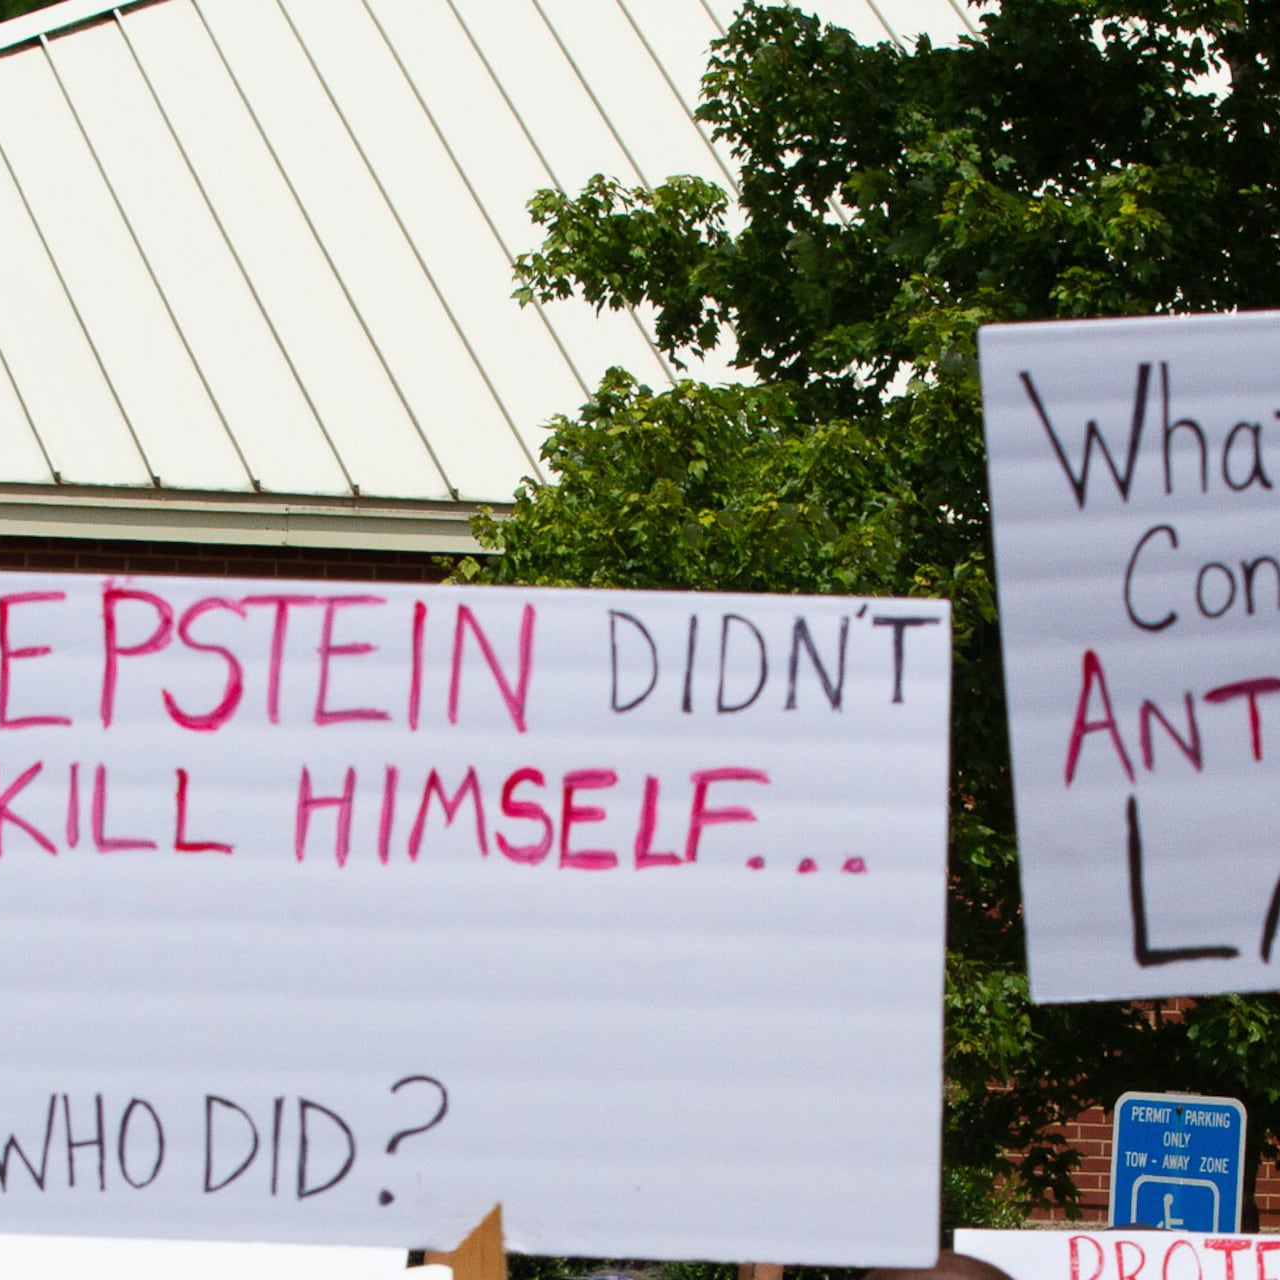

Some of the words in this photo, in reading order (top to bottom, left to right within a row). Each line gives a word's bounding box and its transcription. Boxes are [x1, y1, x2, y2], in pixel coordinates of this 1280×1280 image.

[607, 603, 941, 714] DIDN'T
[295, 764, 868, 873] HIMSELF...
[203, 1077, 449, 1206] DID?
[1131, 1105, 1172, 1124] PERMIT
[1185, 1109, 1231, 1128] PARKING
[1163, 1131, 1191, 1148] ONLY
[1199, 1156, 1229, 1174] ZONE
